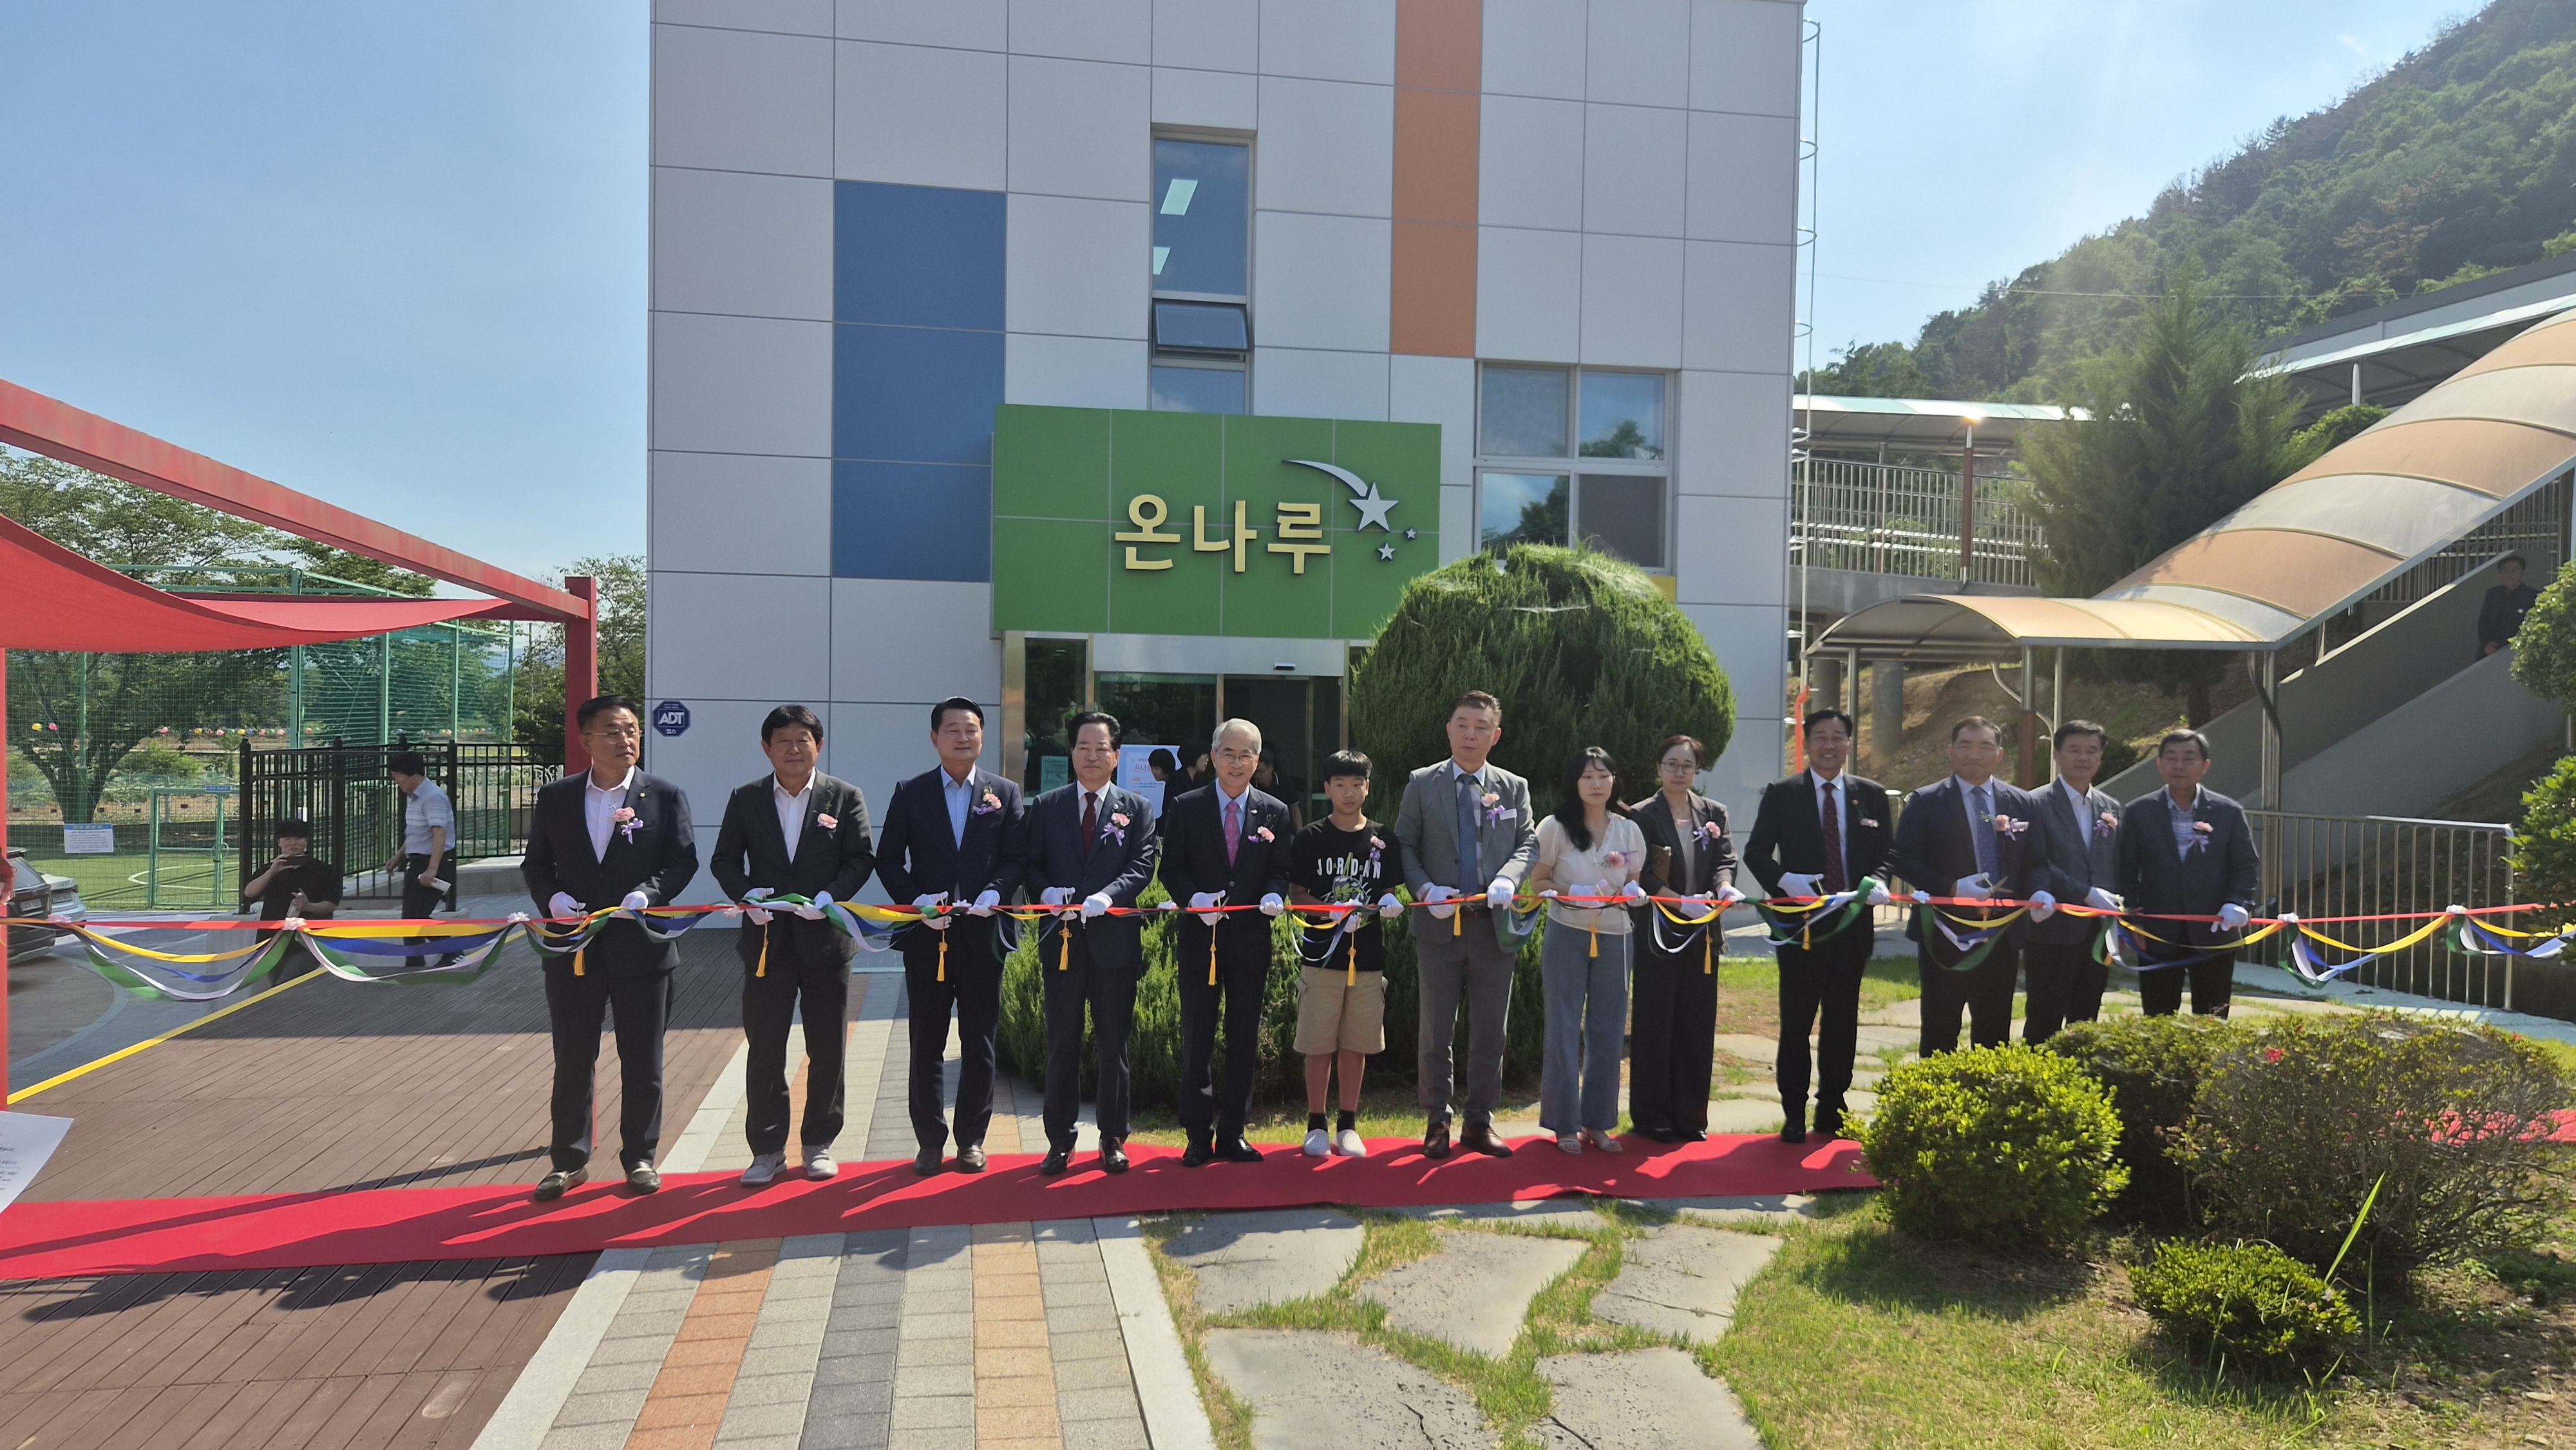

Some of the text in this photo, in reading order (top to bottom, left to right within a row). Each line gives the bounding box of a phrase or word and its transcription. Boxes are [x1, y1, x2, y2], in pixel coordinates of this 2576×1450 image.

[1115, 494, 1331, 574] 온나루
[658, 711, 685, 724] ADT
[1316, 857, 1381, 879] JORDAN
